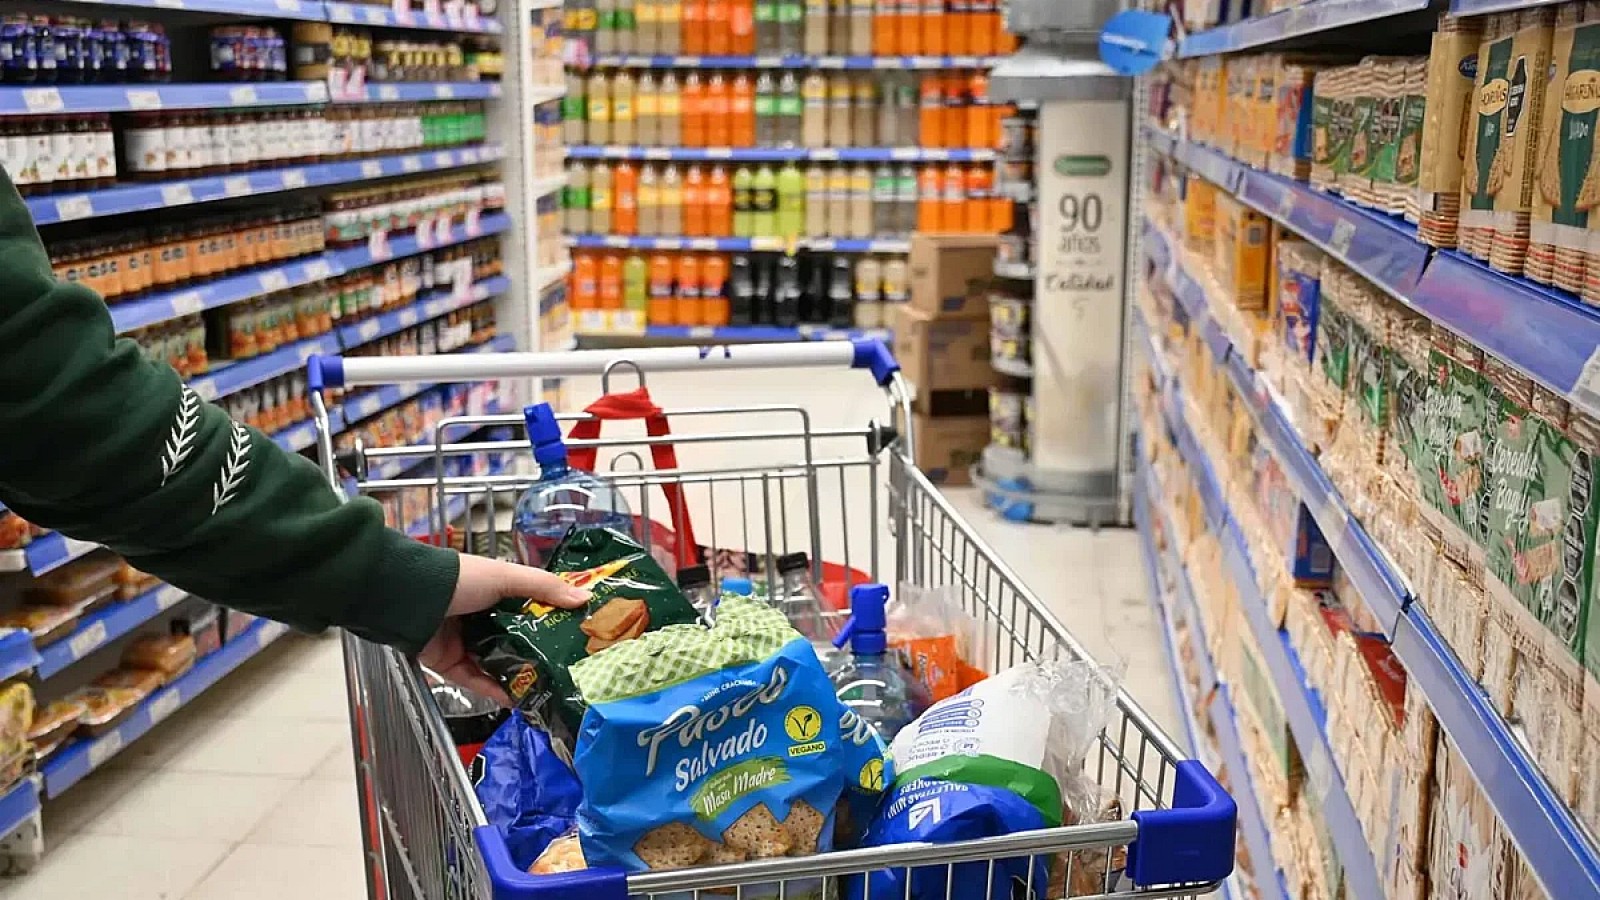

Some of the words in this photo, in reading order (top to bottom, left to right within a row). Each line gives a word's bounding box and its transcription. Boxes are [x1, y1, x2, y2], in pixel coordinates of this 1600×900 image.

[1058, 193, 1102, 232] 90
[675, 718, 768, 792] Salvado
[789, 743, 825, 756] VEGANO
[703, 788, 732, 817] Masa
[733, 765, 777, 796] Madre
